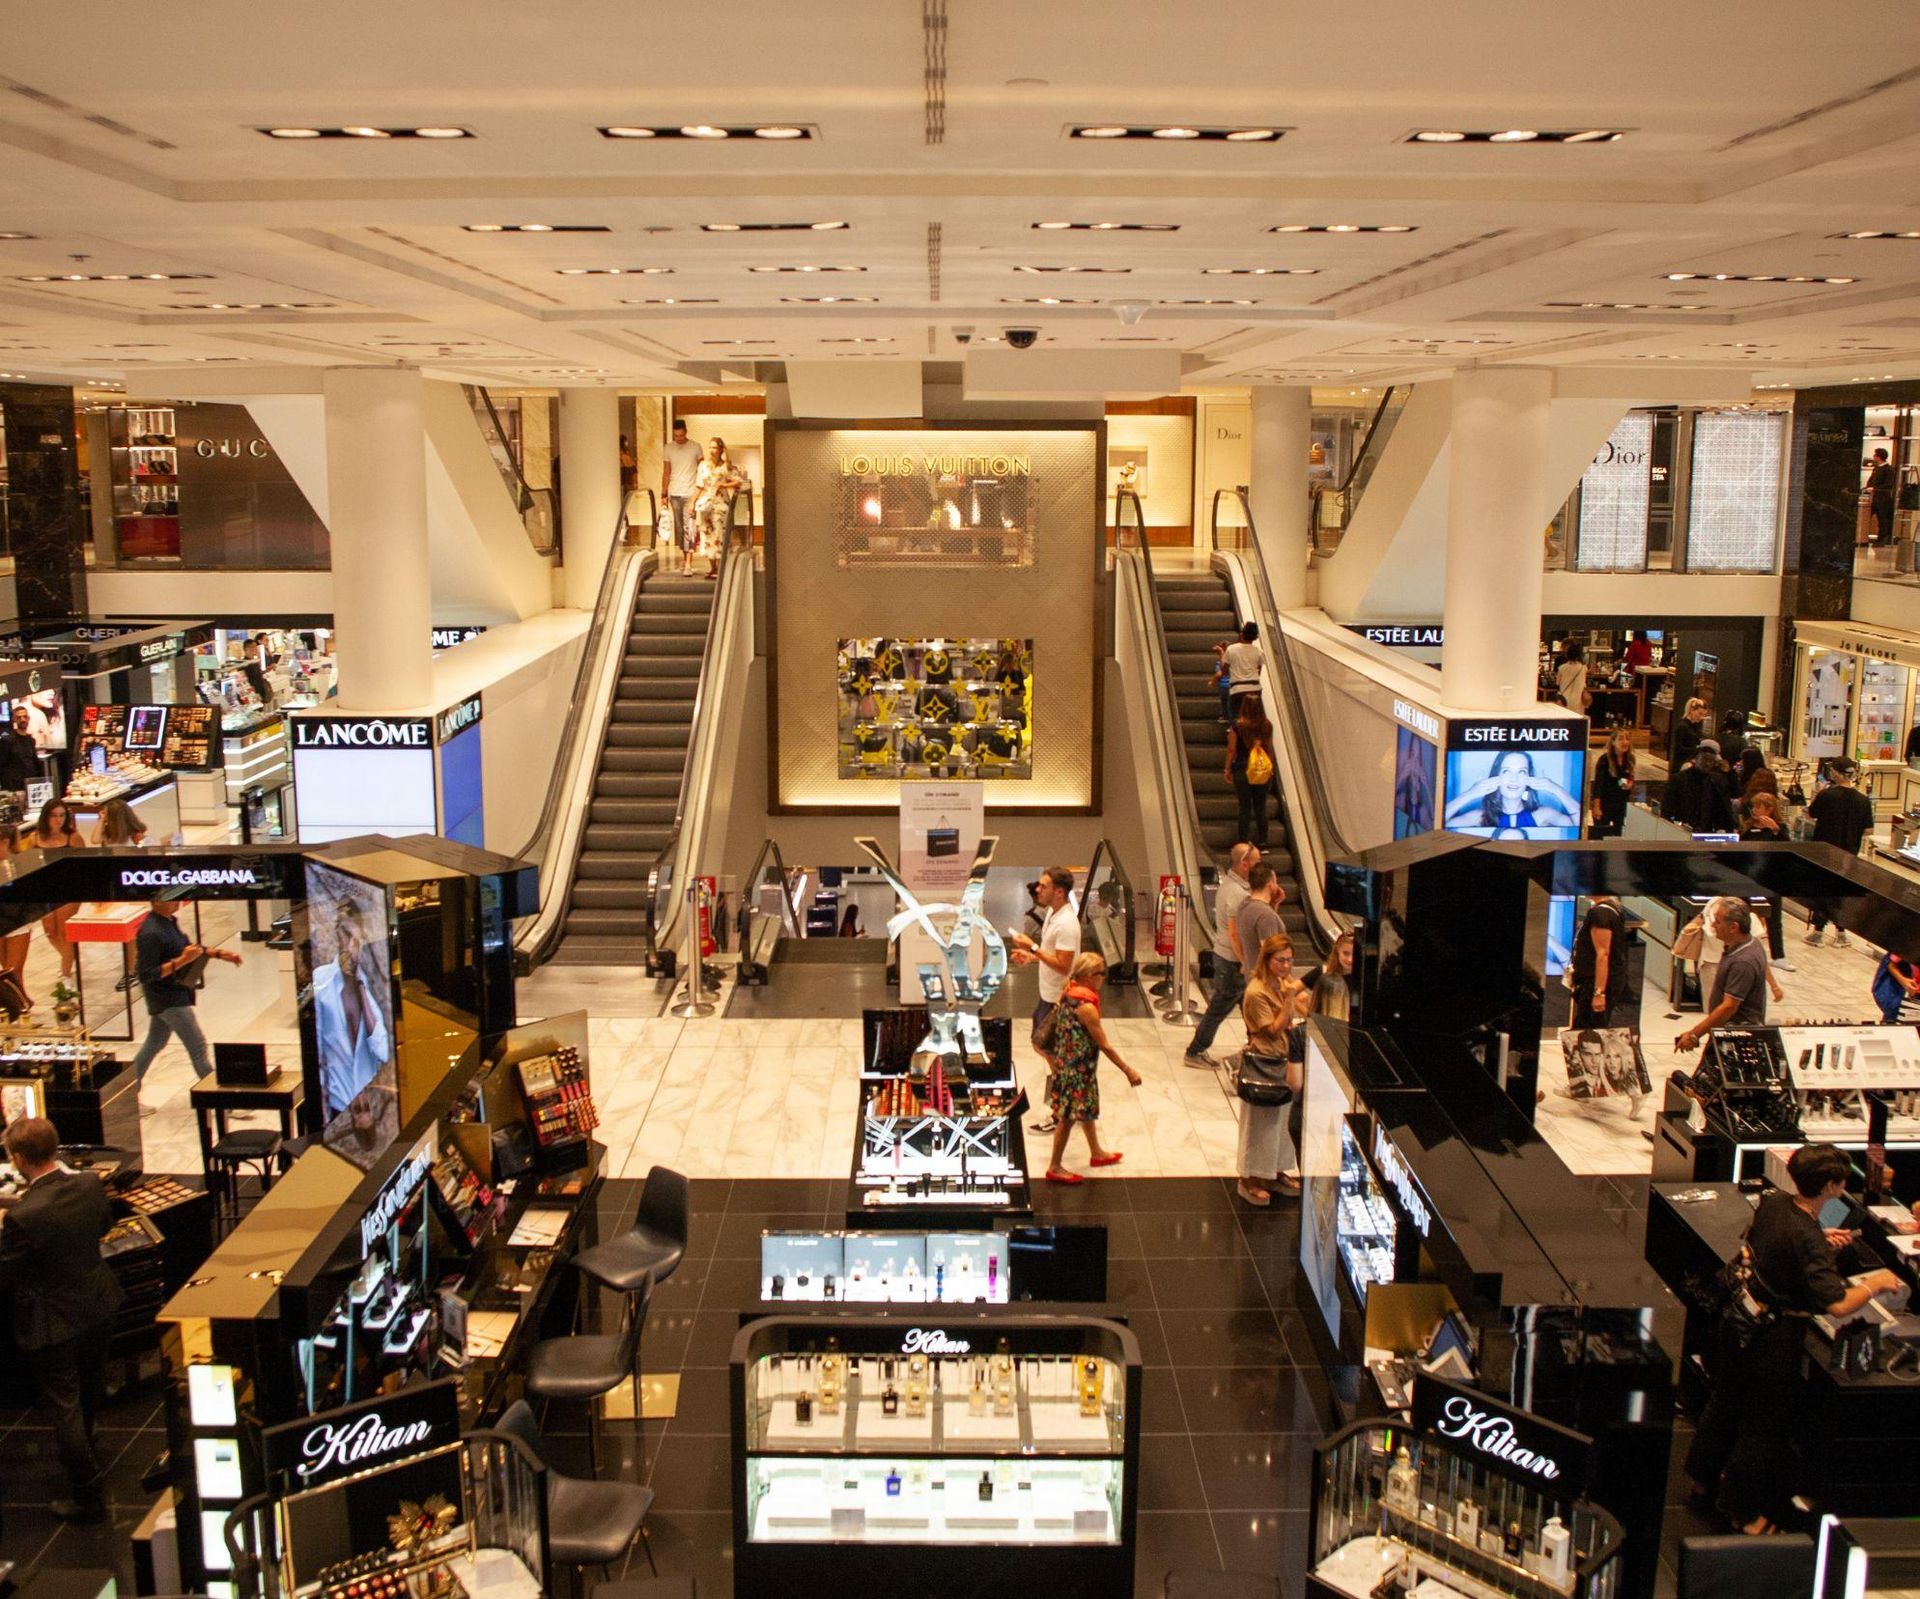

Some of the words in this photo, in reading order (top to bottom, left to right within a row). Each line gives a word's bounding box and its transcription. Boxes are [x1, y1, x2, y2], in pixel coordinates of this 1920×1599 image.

[1217, 427, 1242, 440] Dior
[841, 455, 912, 475] LOUIS
[923, 455, 1030, 475] VUITTON
[140, 638, 178, 657] GUERLAIN
[297, 719, 428, 745] LANCÔME
[1510, 728, 1569, 741] LAUDER
[901, 1327, 971, 1353] Kilian
[297, 1413, 432, 1476] Kilian
[1437, 1396, 1561, 1480] Kilian
